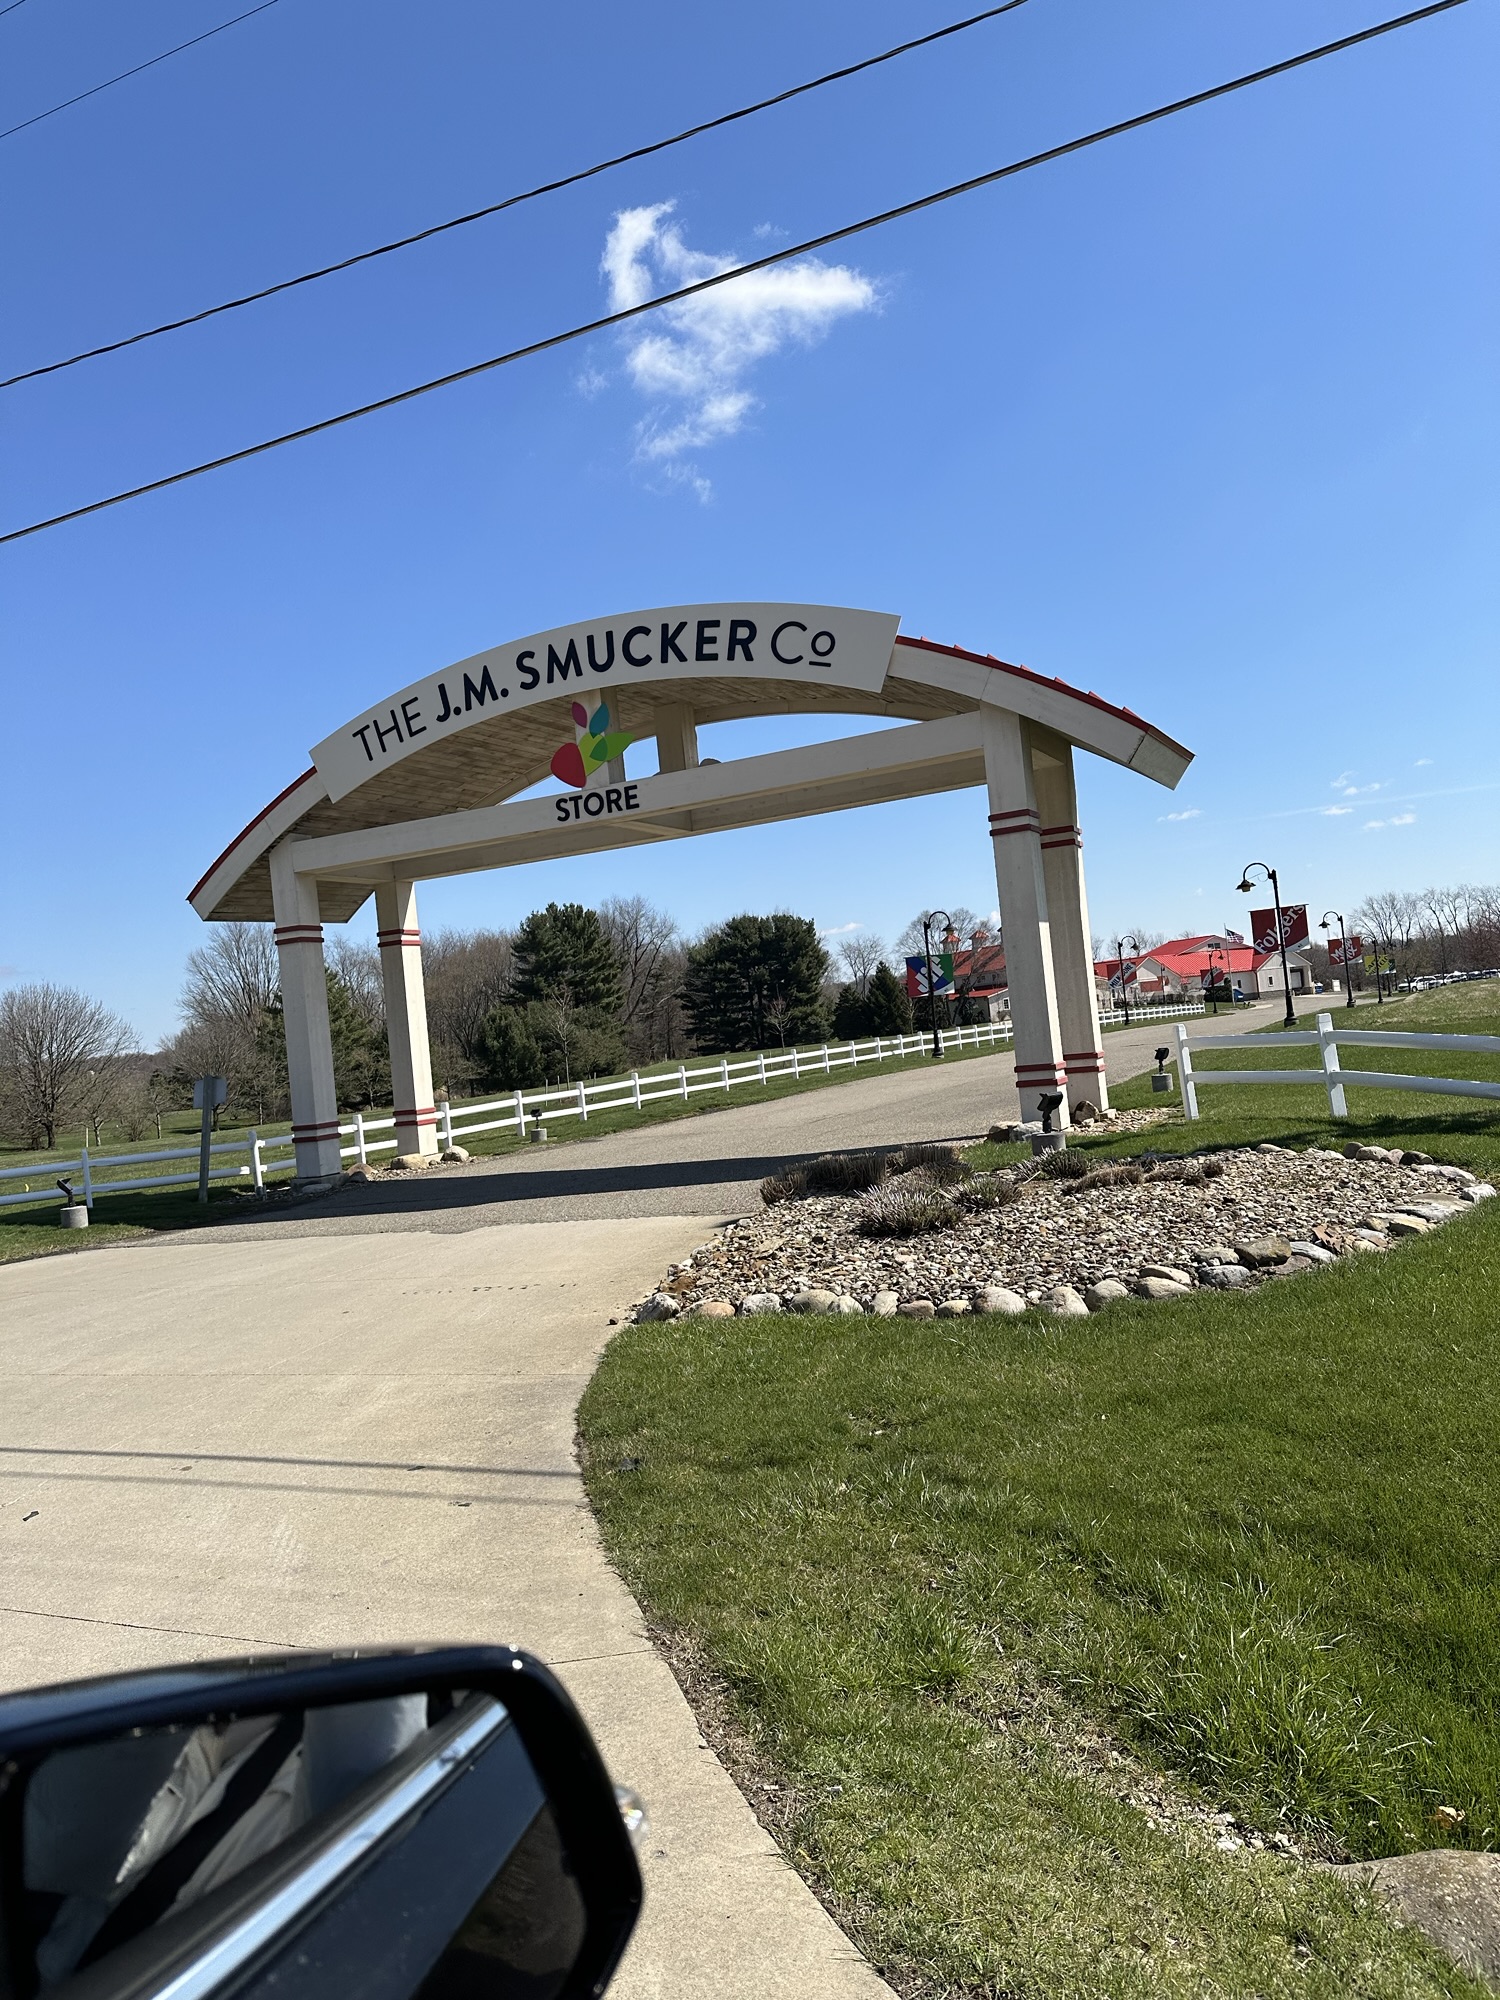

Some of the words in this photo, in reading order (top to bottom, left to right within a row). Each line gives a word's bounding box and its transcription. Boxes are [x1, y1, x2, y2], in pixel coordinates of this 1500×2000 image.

[352, 696, 427, 761] THE
[436, 664, 509, 723] J.M.
[515, 619, 757, 690] SMUCKER
[555, 784, 640, 822] STORE
